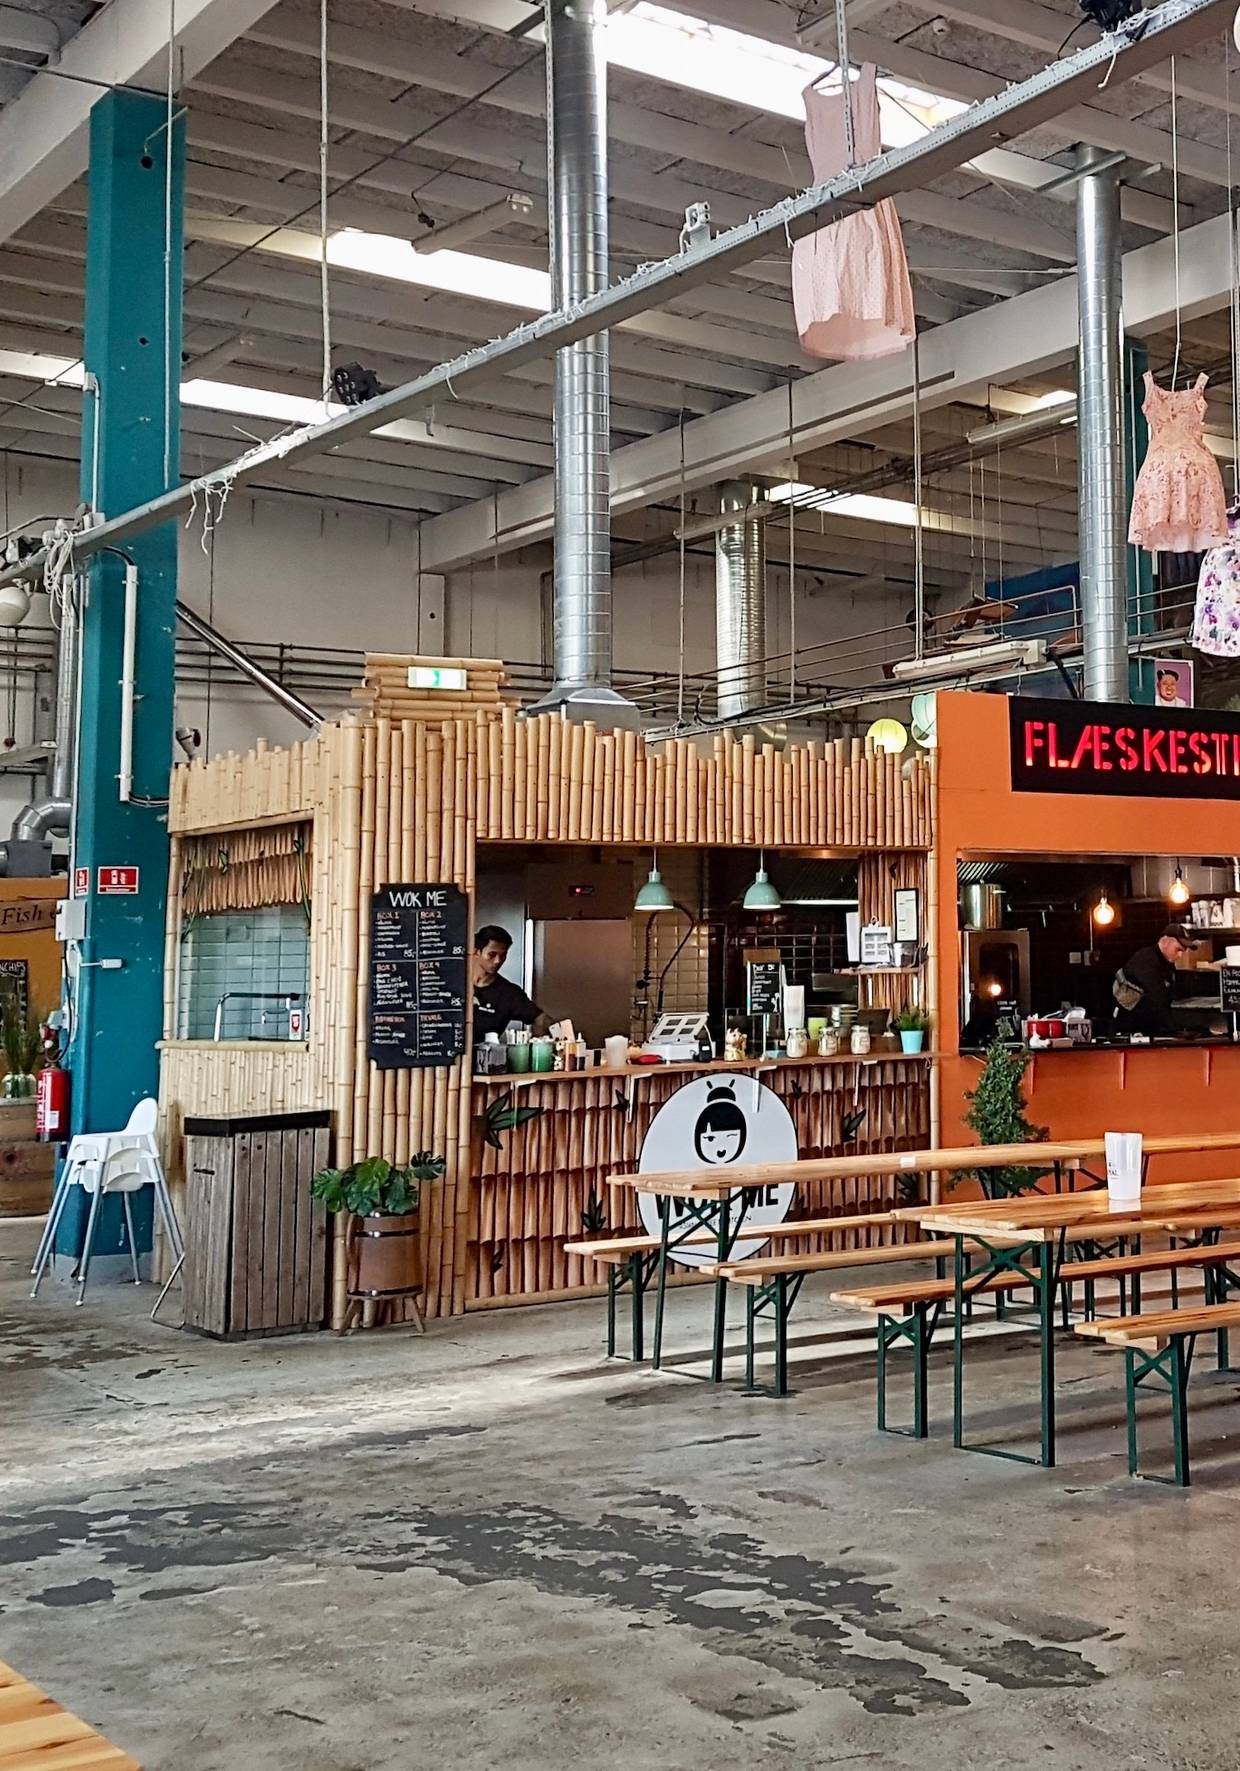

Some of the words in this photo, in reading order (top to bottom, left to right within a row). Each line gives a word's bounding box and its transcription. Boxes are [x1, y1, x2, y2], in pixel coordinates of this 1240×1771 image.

[389, 890, 422, 907] WOK
[426, 890, 447, 907] ME
[1, 905, 42, 925] Fish
[377, 912, 393, 920] BOX
[420, 911, 435, 919] BOX
[376, 964, 391, 972] BOX
[419, 962, 434, 970] BOX
